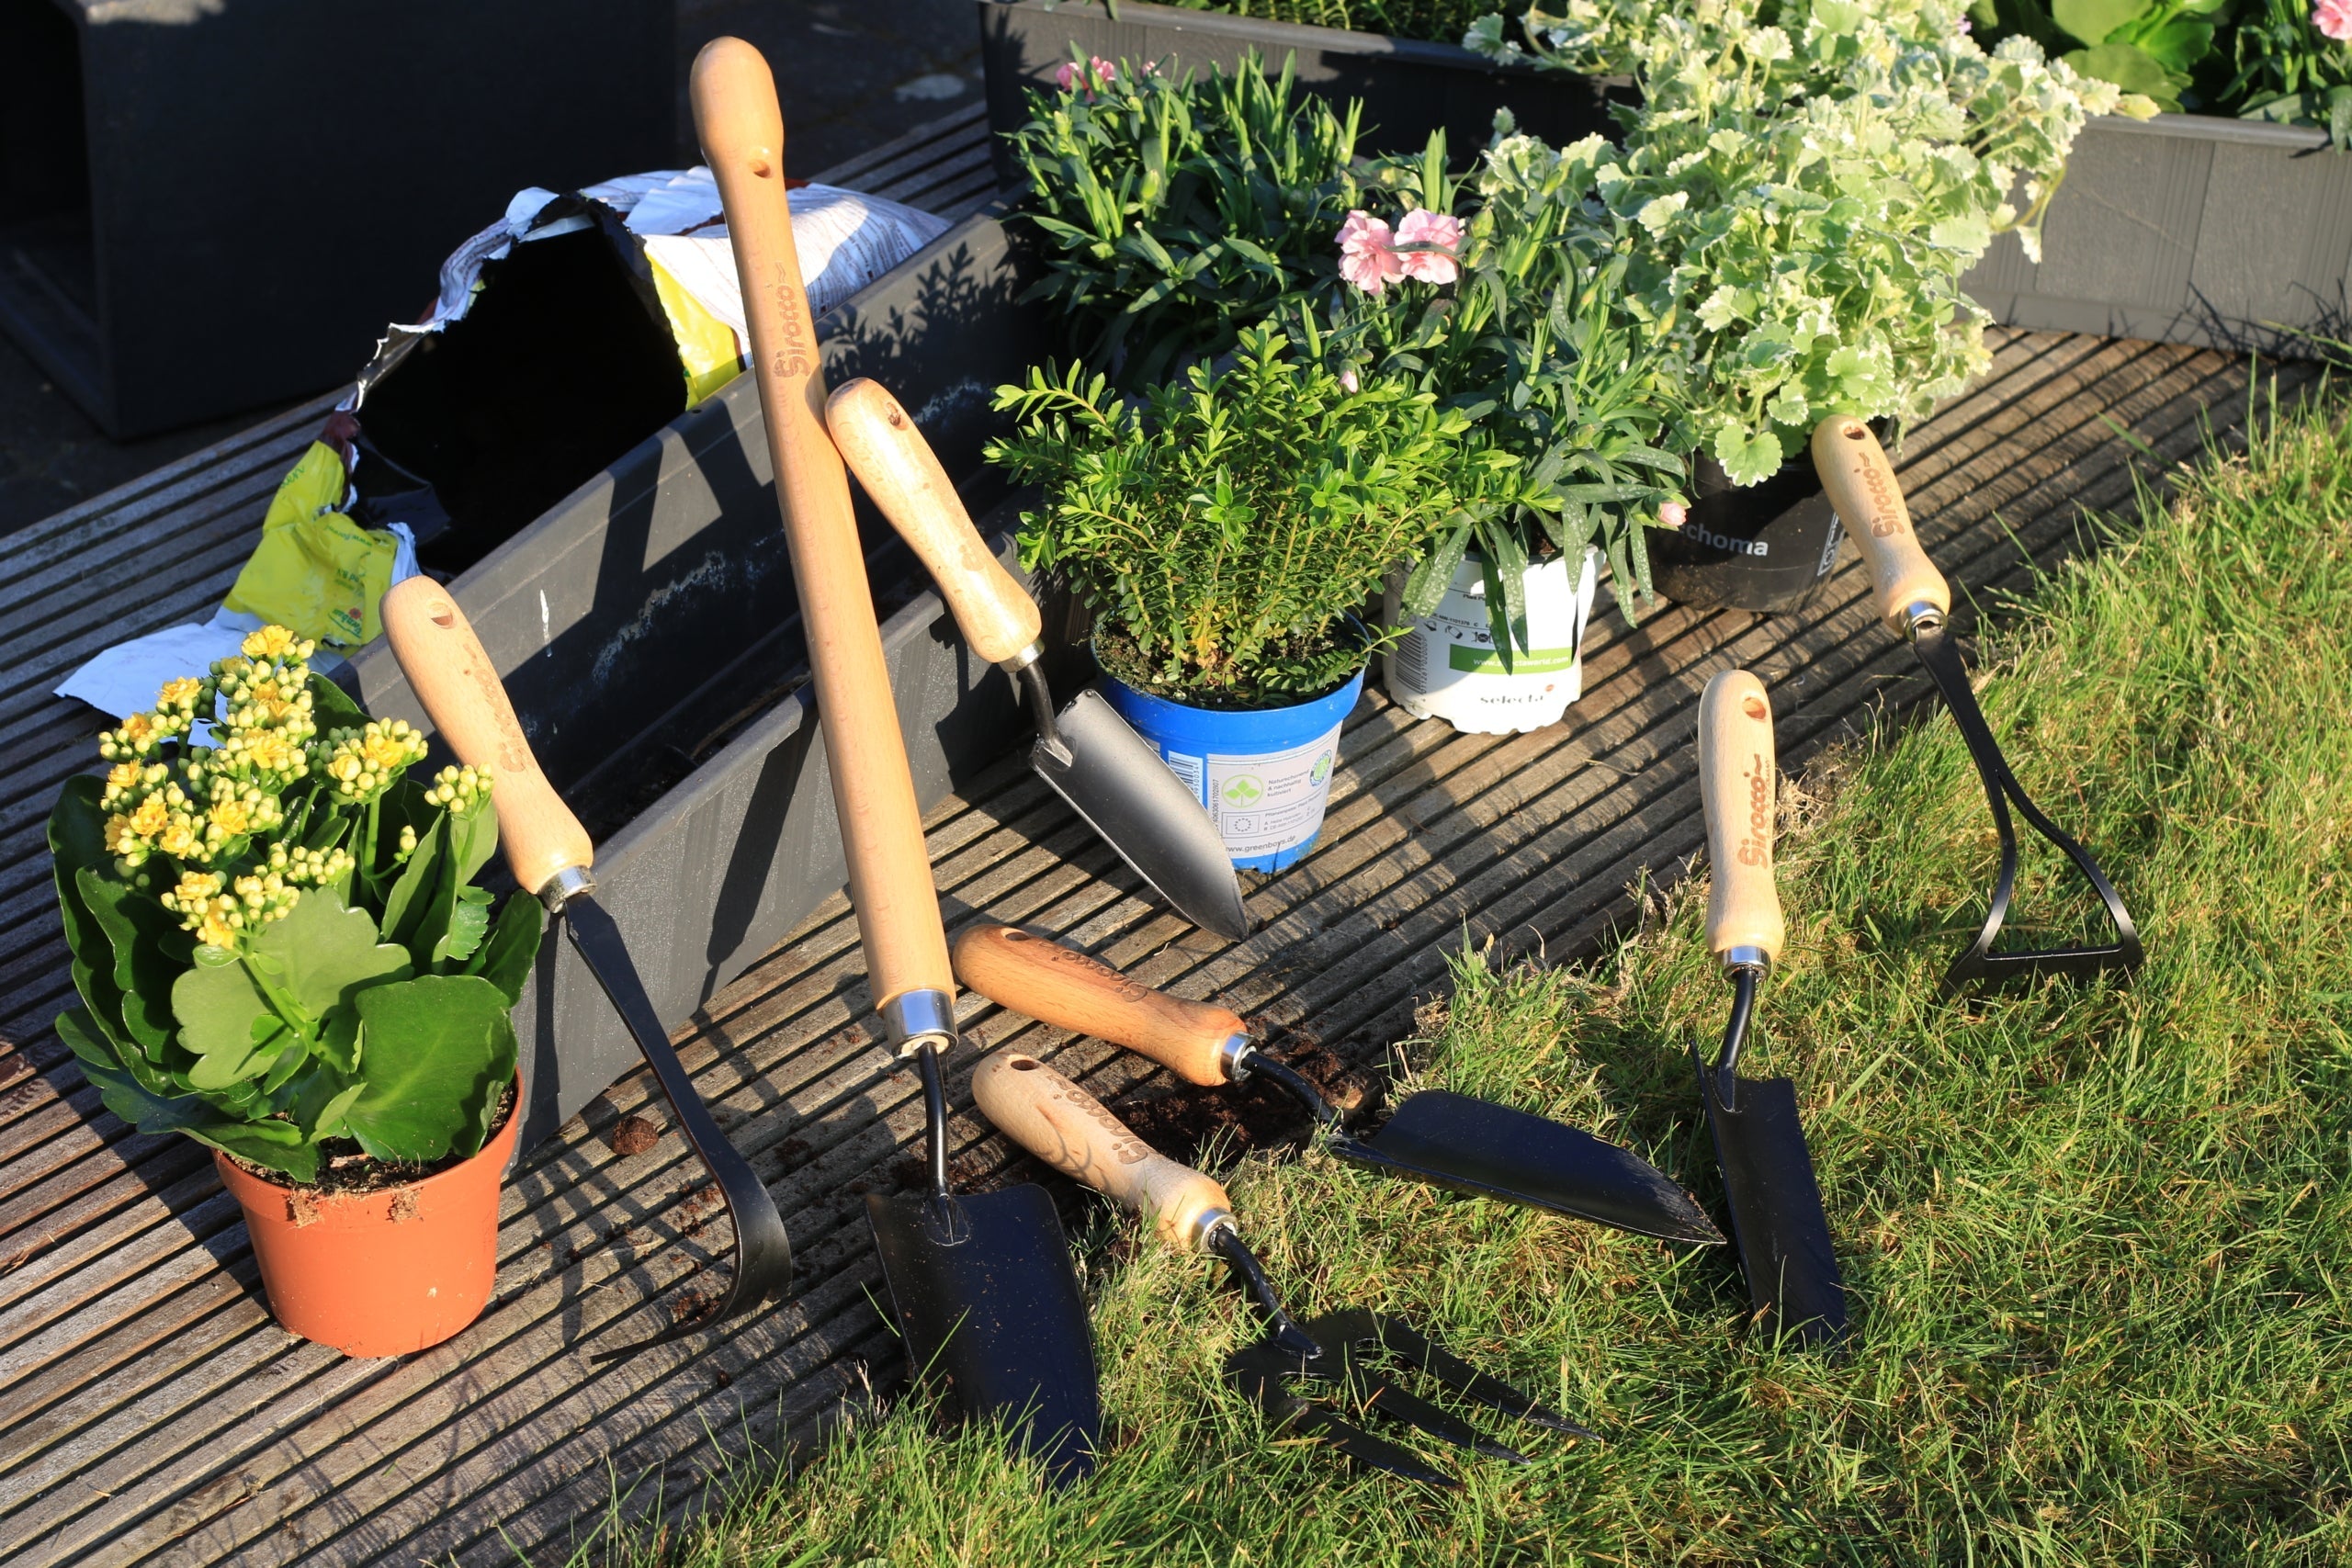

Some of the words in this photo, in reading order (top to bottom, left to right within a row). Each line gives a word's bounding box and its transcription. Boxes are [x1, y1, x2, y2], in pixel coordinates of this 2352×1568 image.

[774, 284, 810, 378] Sirocco
[1863, 468, 1905, 537] Sirocco
[1737, 775, 1769, 869] Sirocco
